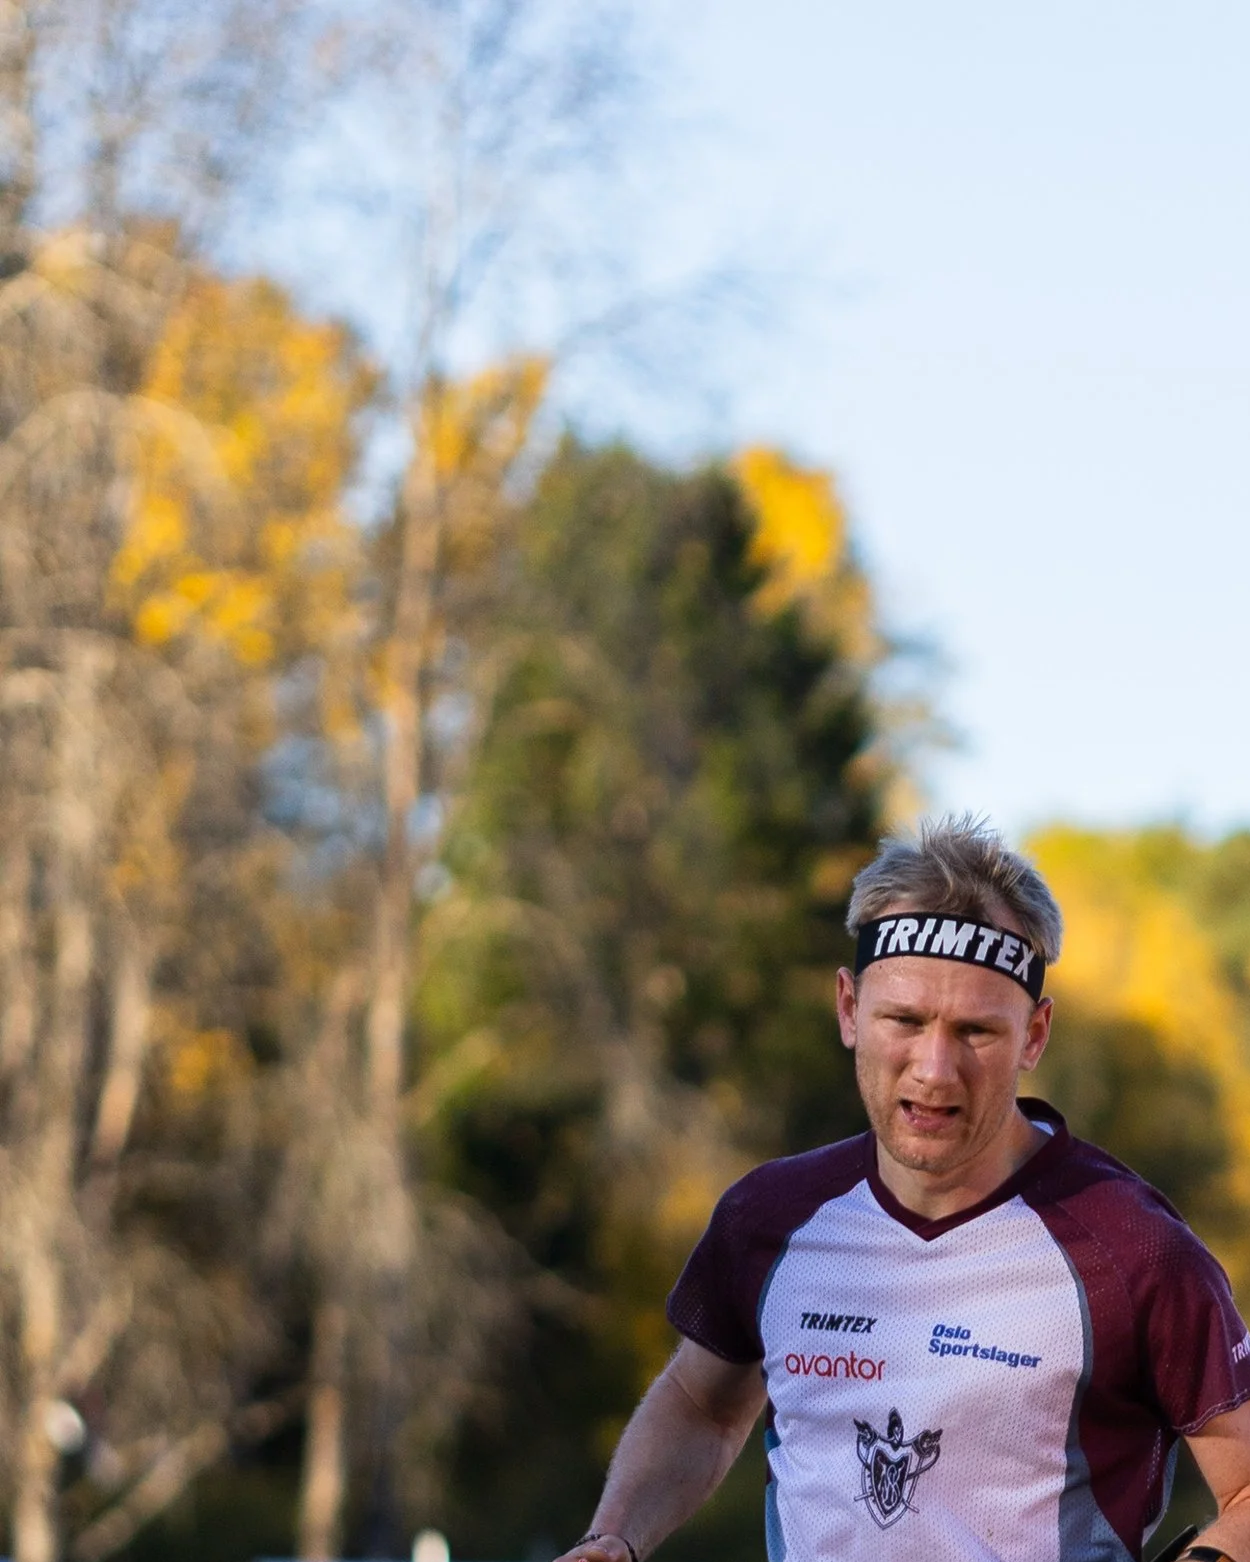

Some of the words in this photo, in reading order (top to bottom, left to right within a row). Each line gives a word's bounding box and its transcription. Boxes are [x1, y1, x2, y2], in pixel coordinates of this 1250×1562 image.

[873, 918, 1035, 983] TRIMTEX
[800, 1312, 877, 1333] TRIMTEX
[932, 1324, 971, 1340] Oslo
[785, 1352, 885, 1381] avantor
[928, 1339, 1042, 1368] Sportslager
